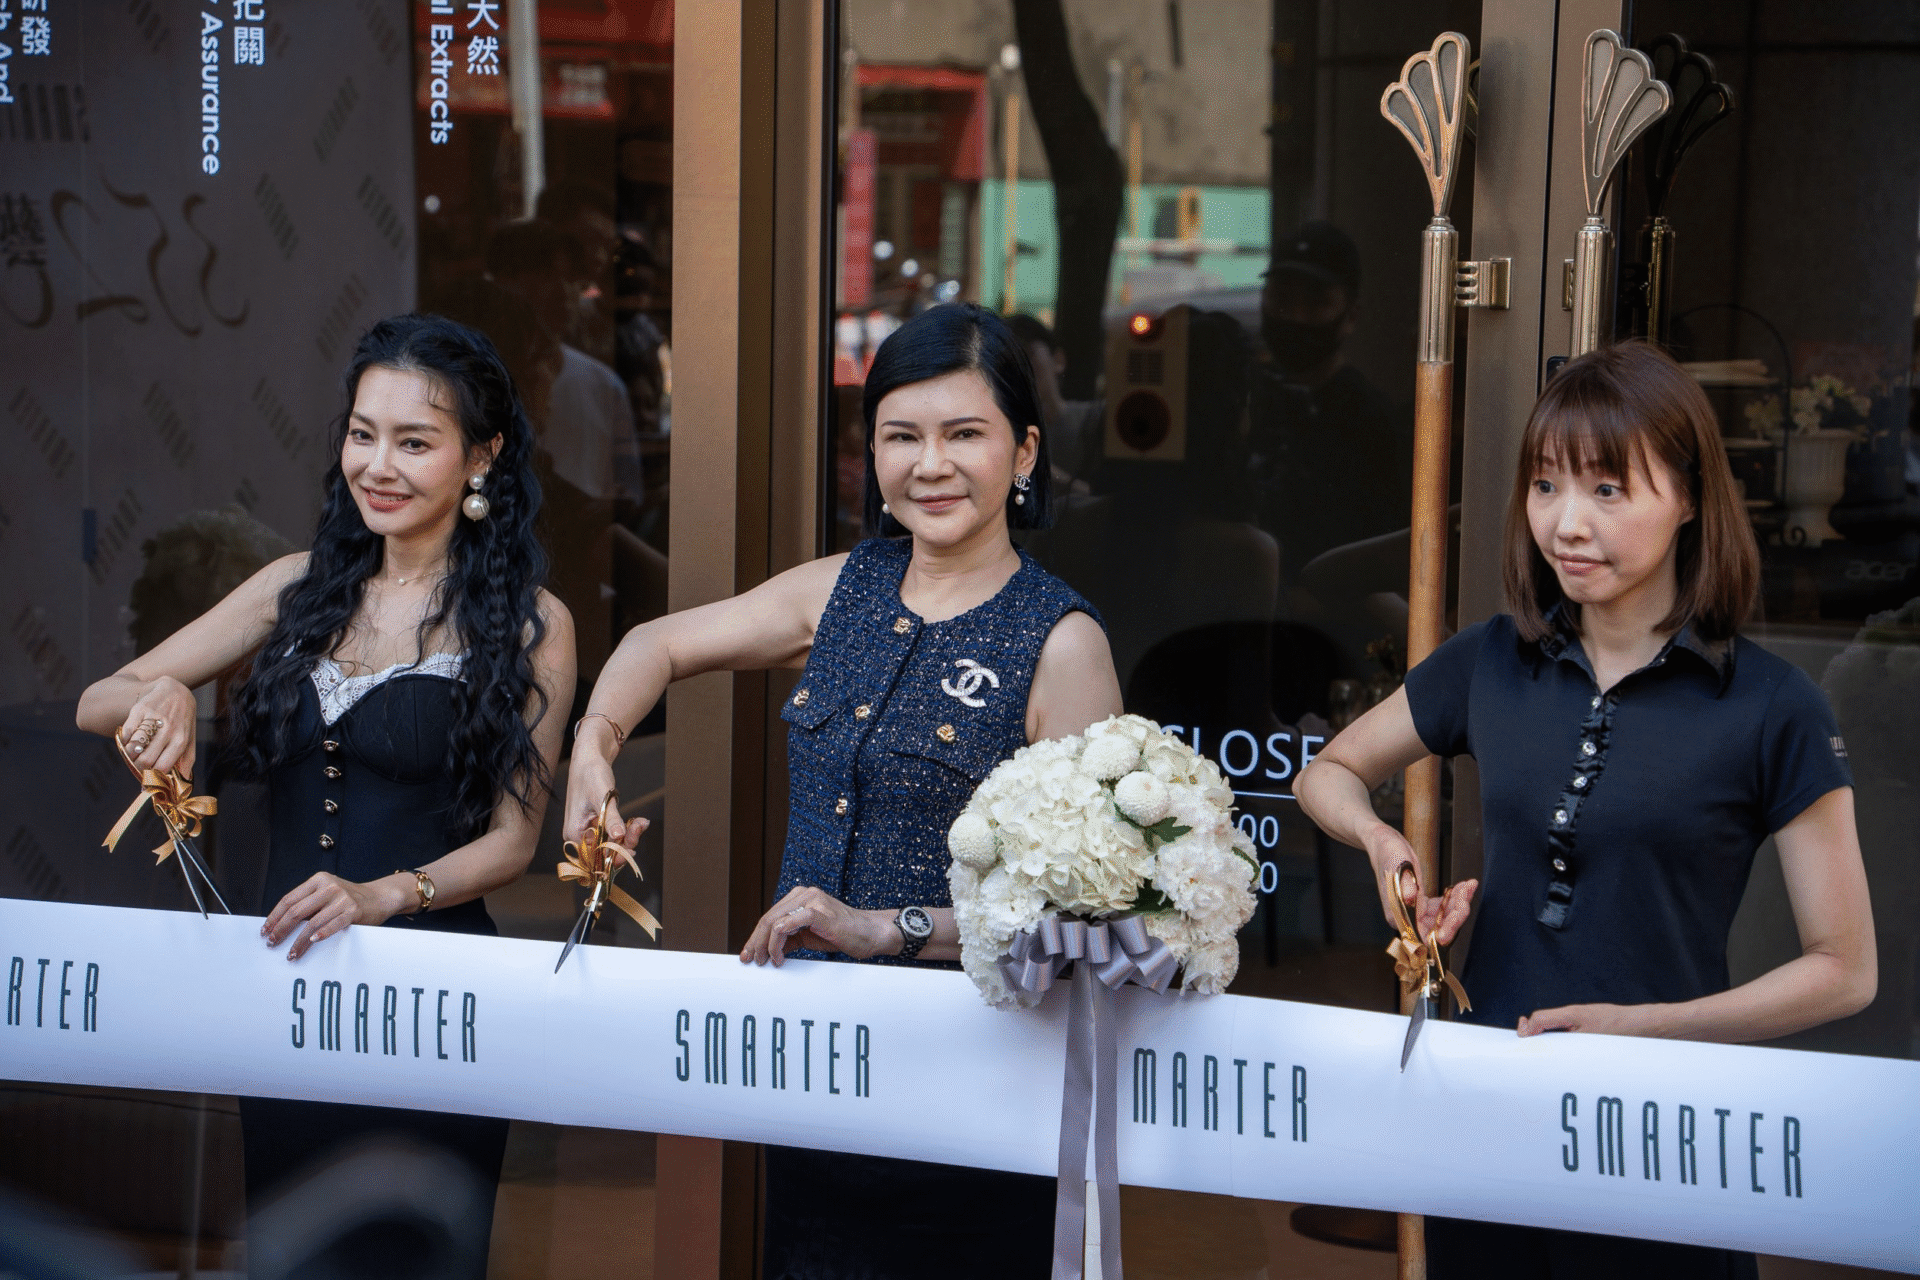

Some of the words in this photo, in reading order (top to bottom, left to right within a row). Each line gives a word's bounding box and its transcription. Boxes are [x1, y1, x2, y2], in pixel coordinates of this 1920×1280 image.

[20, 0, 51, 55] 發
[201, 11, 223, 175] Assurance
[431, 24, 453, 145] Extracts
[1233, 814, 1279, 848] 00
[7, 956, 100, 1033] RTER
[291, 977, 478, 1064] SMARTER
[676, 1009, 871, 1098] SMARTER
[1133, 1047, 1308, 1143] MARTER
[1561, 1092, 1804, 1199] SMARTER
